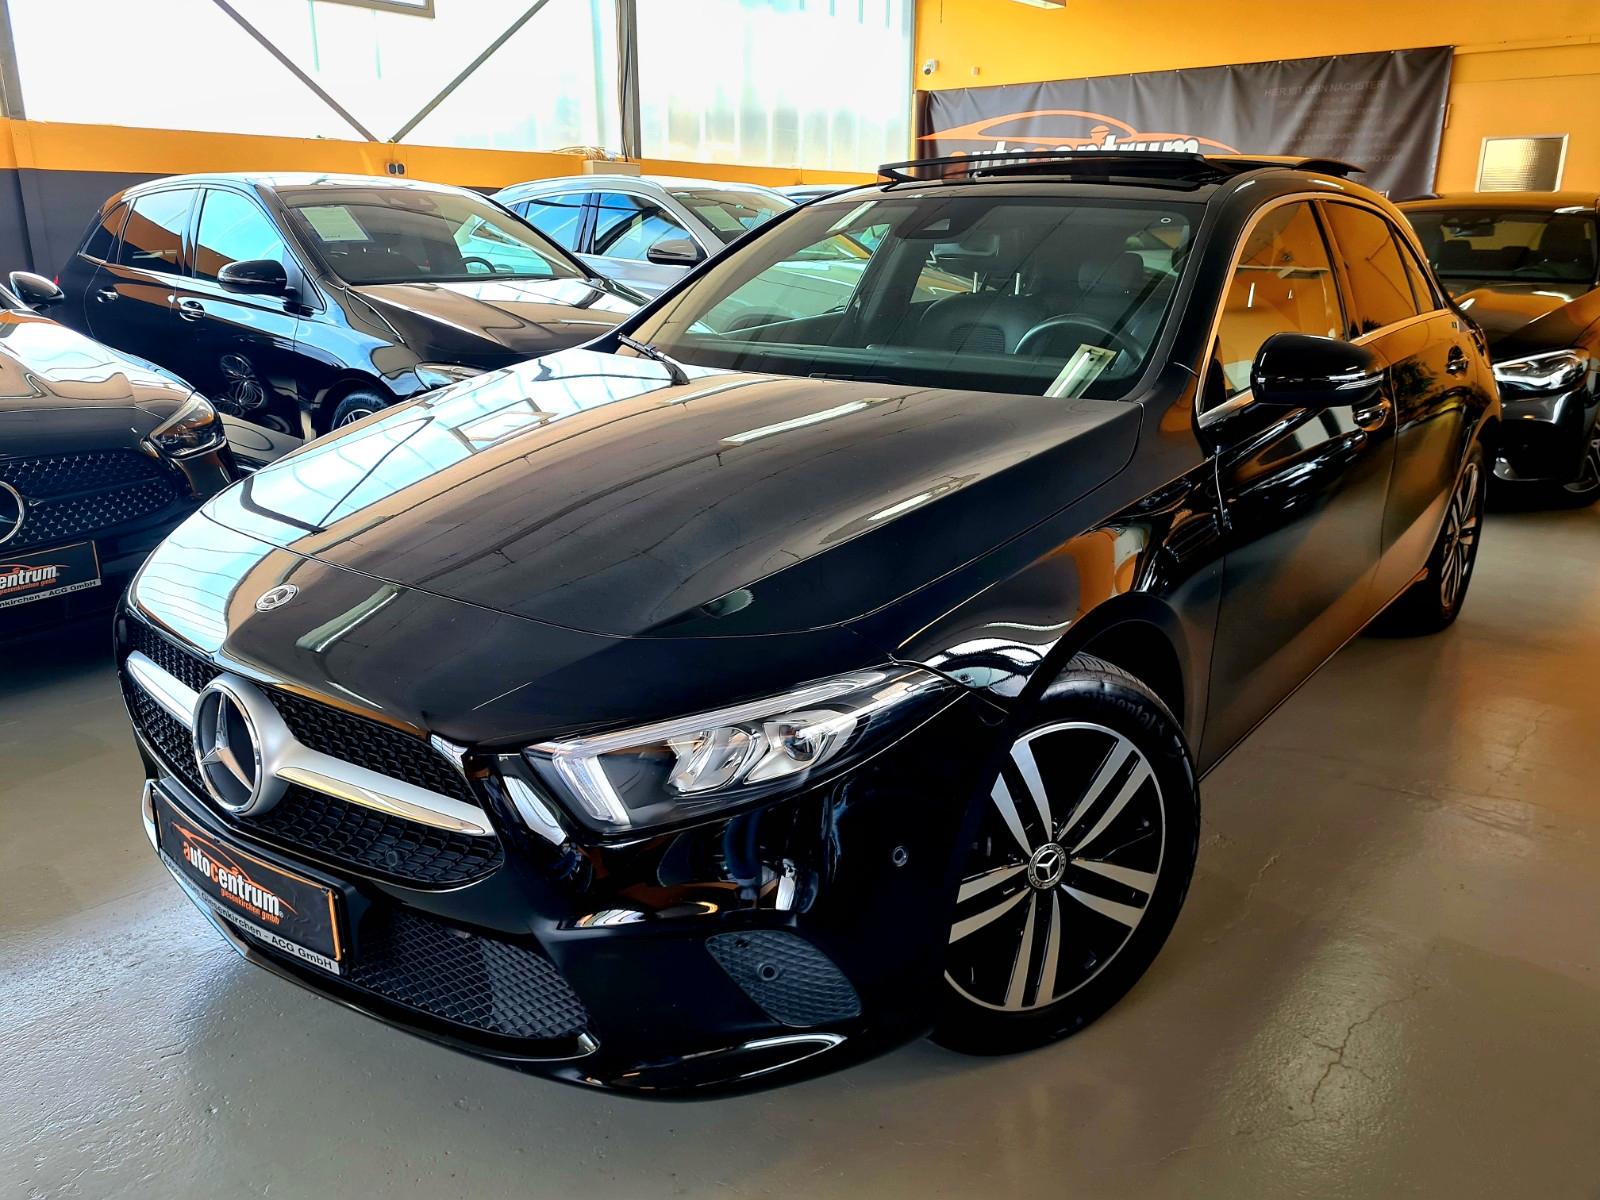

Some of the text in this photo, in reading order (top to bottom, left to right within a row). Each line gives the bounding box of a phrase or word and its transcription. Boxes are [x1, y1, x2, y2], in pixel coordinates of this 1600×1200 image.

[183, 841, 280, 917] autocentrum
[271, 936, 294, 952] ACG
[298, 947, 333, 970] GmbH
